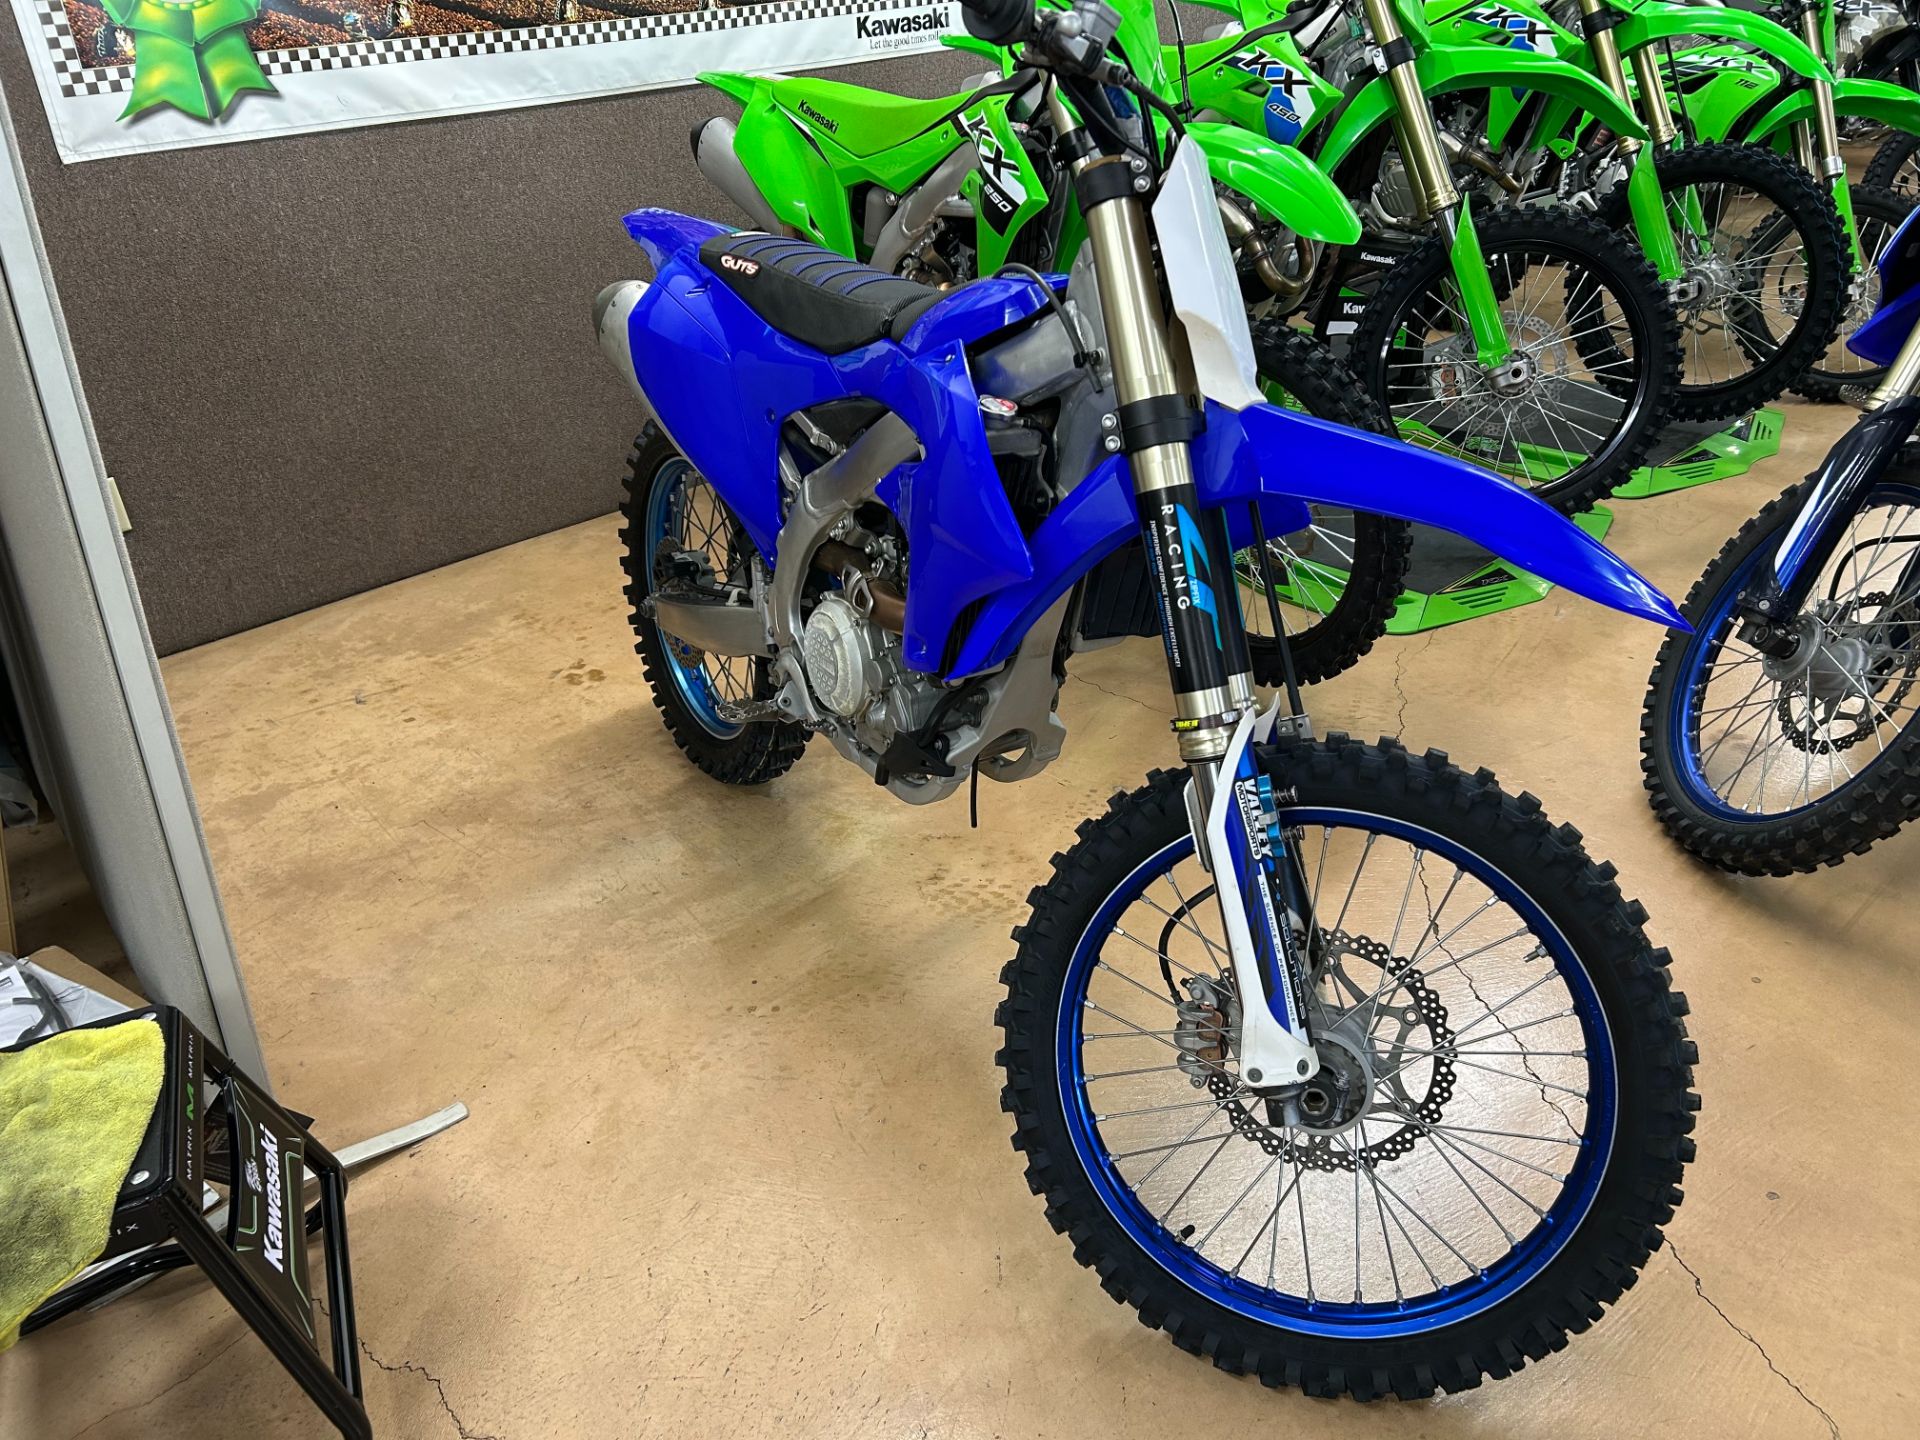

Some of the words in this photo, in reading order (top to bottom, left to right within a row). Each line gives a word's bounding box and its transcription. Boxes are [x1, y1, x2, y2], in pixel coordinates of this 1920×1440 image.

[856, 6, 950, 39] Kawasaki
[870, 38, 881, 50] Let
[882, 36, 893, 48] the
[893, 34, 910, 49] good
[910, 33, 927, 44] times
[1477, 3, 1559, 48] KX
[1239, 47, 1316, 101] KX
[1735, 78, 1759, 90] 112
[797, 99, 840, 135] Kawasaki
[1267, 103, 1302, 124] 450
[964, 108, 1021, 186] KX
[983, 183, 1013, 213] 250
[720, 254, 760, 276] GUTS
[1149, 519, 1162, 556] INSPIRING
[1156, 556, 1169, 596] CONFIDENCE
[1163, 597, 1174, 627] THROUGH
[1160, 503, 1191, 611] RACING
[1236, 783, 1261, 857] MOTORSPORTS
[1260, 881, 1269, 899] THE
[1265, 902, 1278, 939] SCIENCE
[1274, 943, 1281, 955] OF
[1278, 958, 1297, 1023] PERFORMANCE
[1280, 912, 1307, 1020] SOLUTIONS
[259, 1122, 284, 1274] Kawasaki
